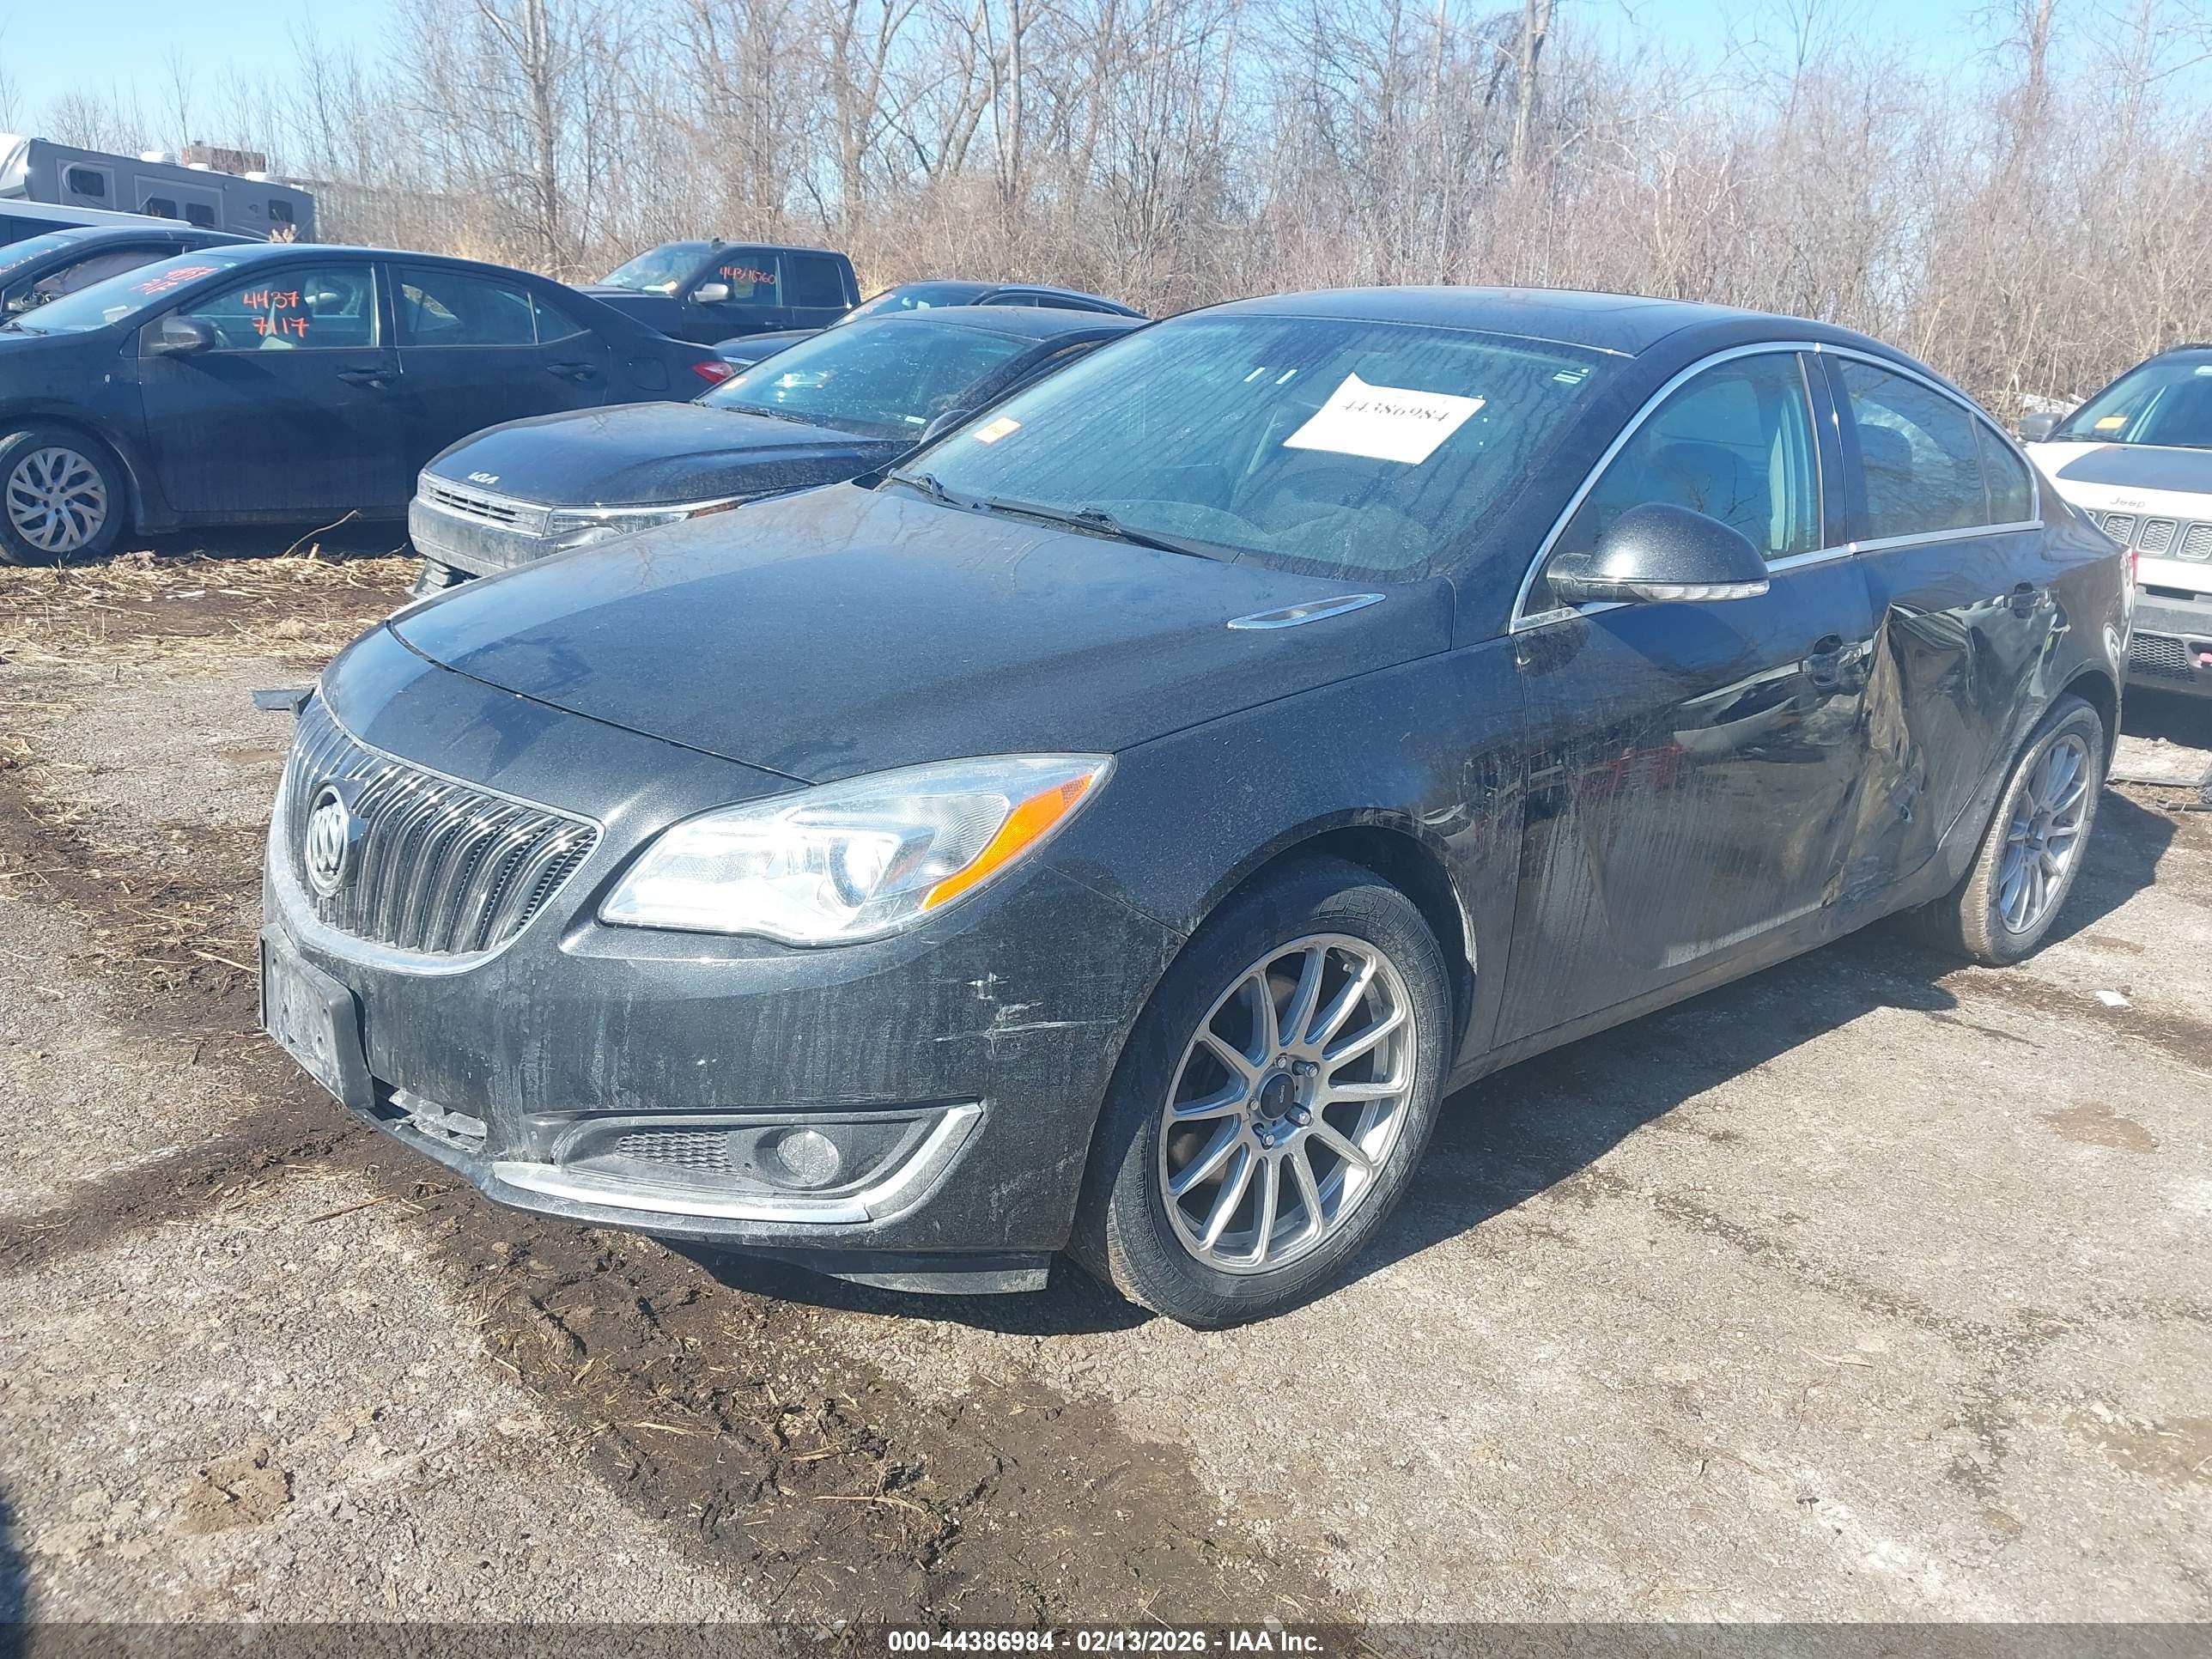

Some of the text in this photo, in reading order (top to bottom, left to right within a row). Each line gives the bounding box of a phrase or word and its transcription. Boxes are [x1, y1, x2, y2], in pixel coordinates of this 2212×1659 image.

[243, 289, 299, 309] 4437
[252, 316, 309, 337] 7117
[2110, 497, 2146, 508] Jeep
